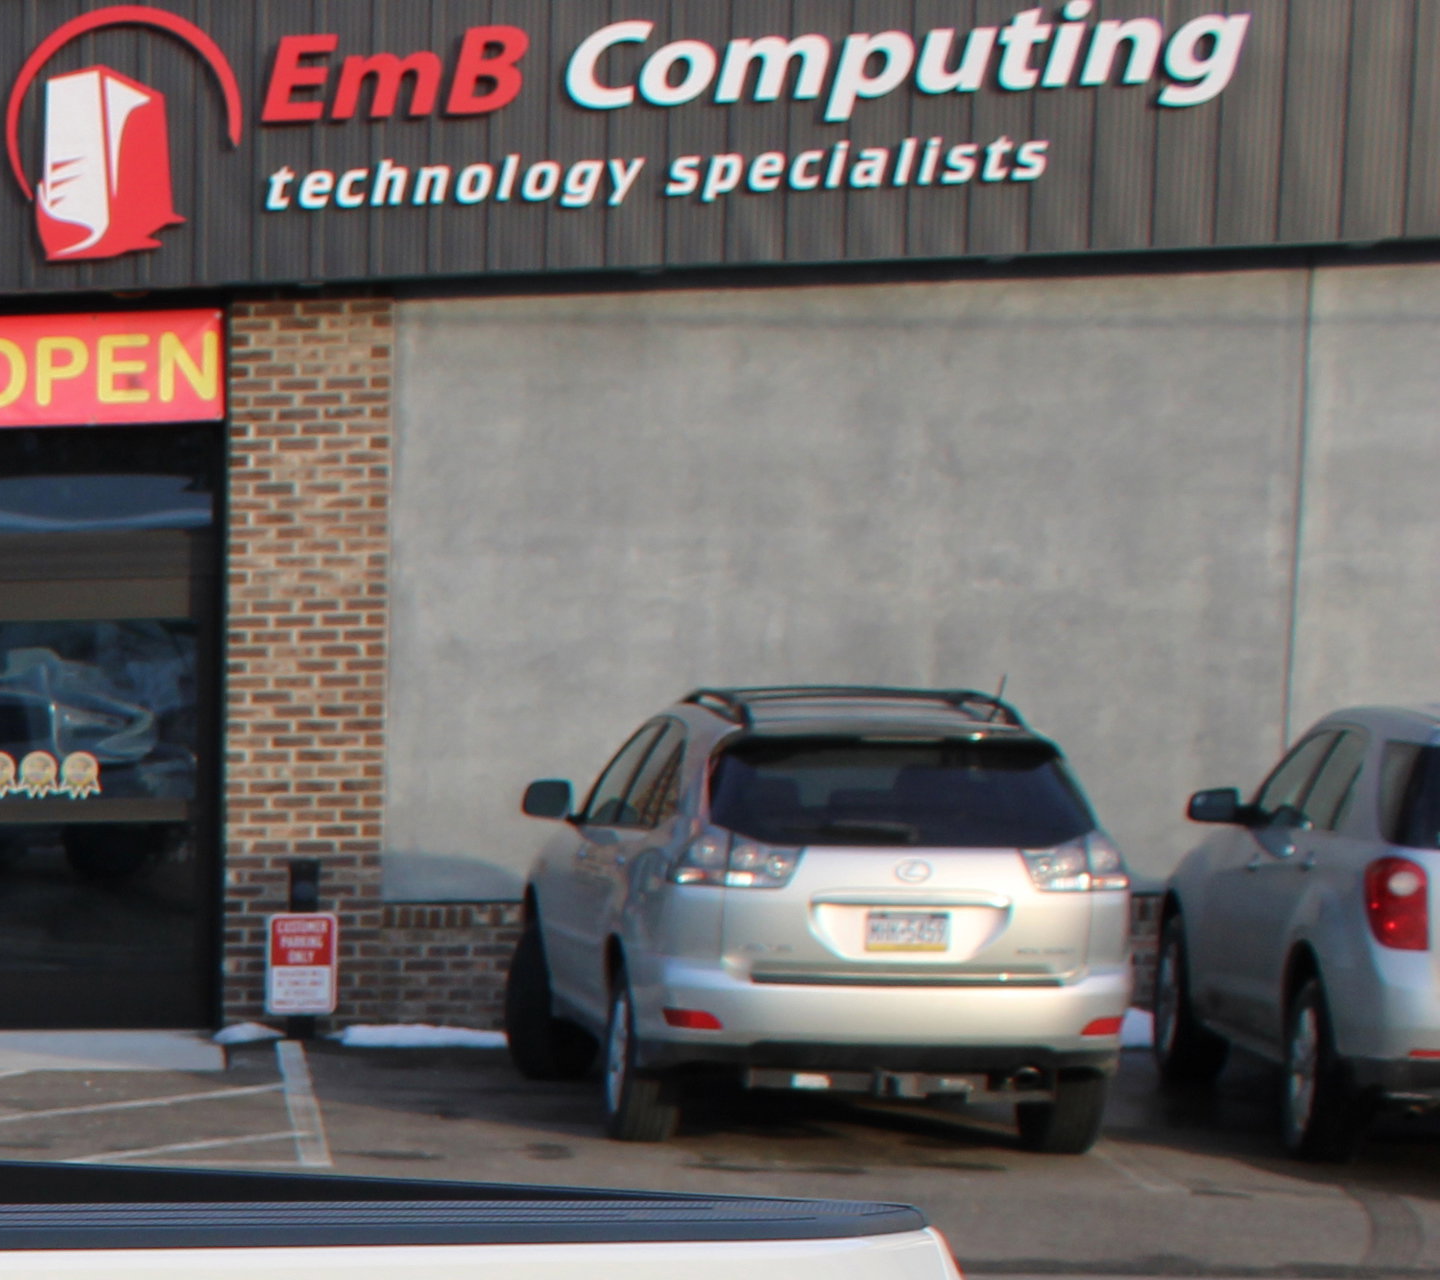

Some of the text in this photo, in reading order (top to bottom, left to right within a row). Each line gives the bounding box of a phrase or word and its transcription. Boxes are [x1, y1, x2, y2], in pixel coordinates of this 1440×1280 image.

[259, 2, 1251, 126] EmB Computing
[264, 122, 1051, 213] technology specialists
